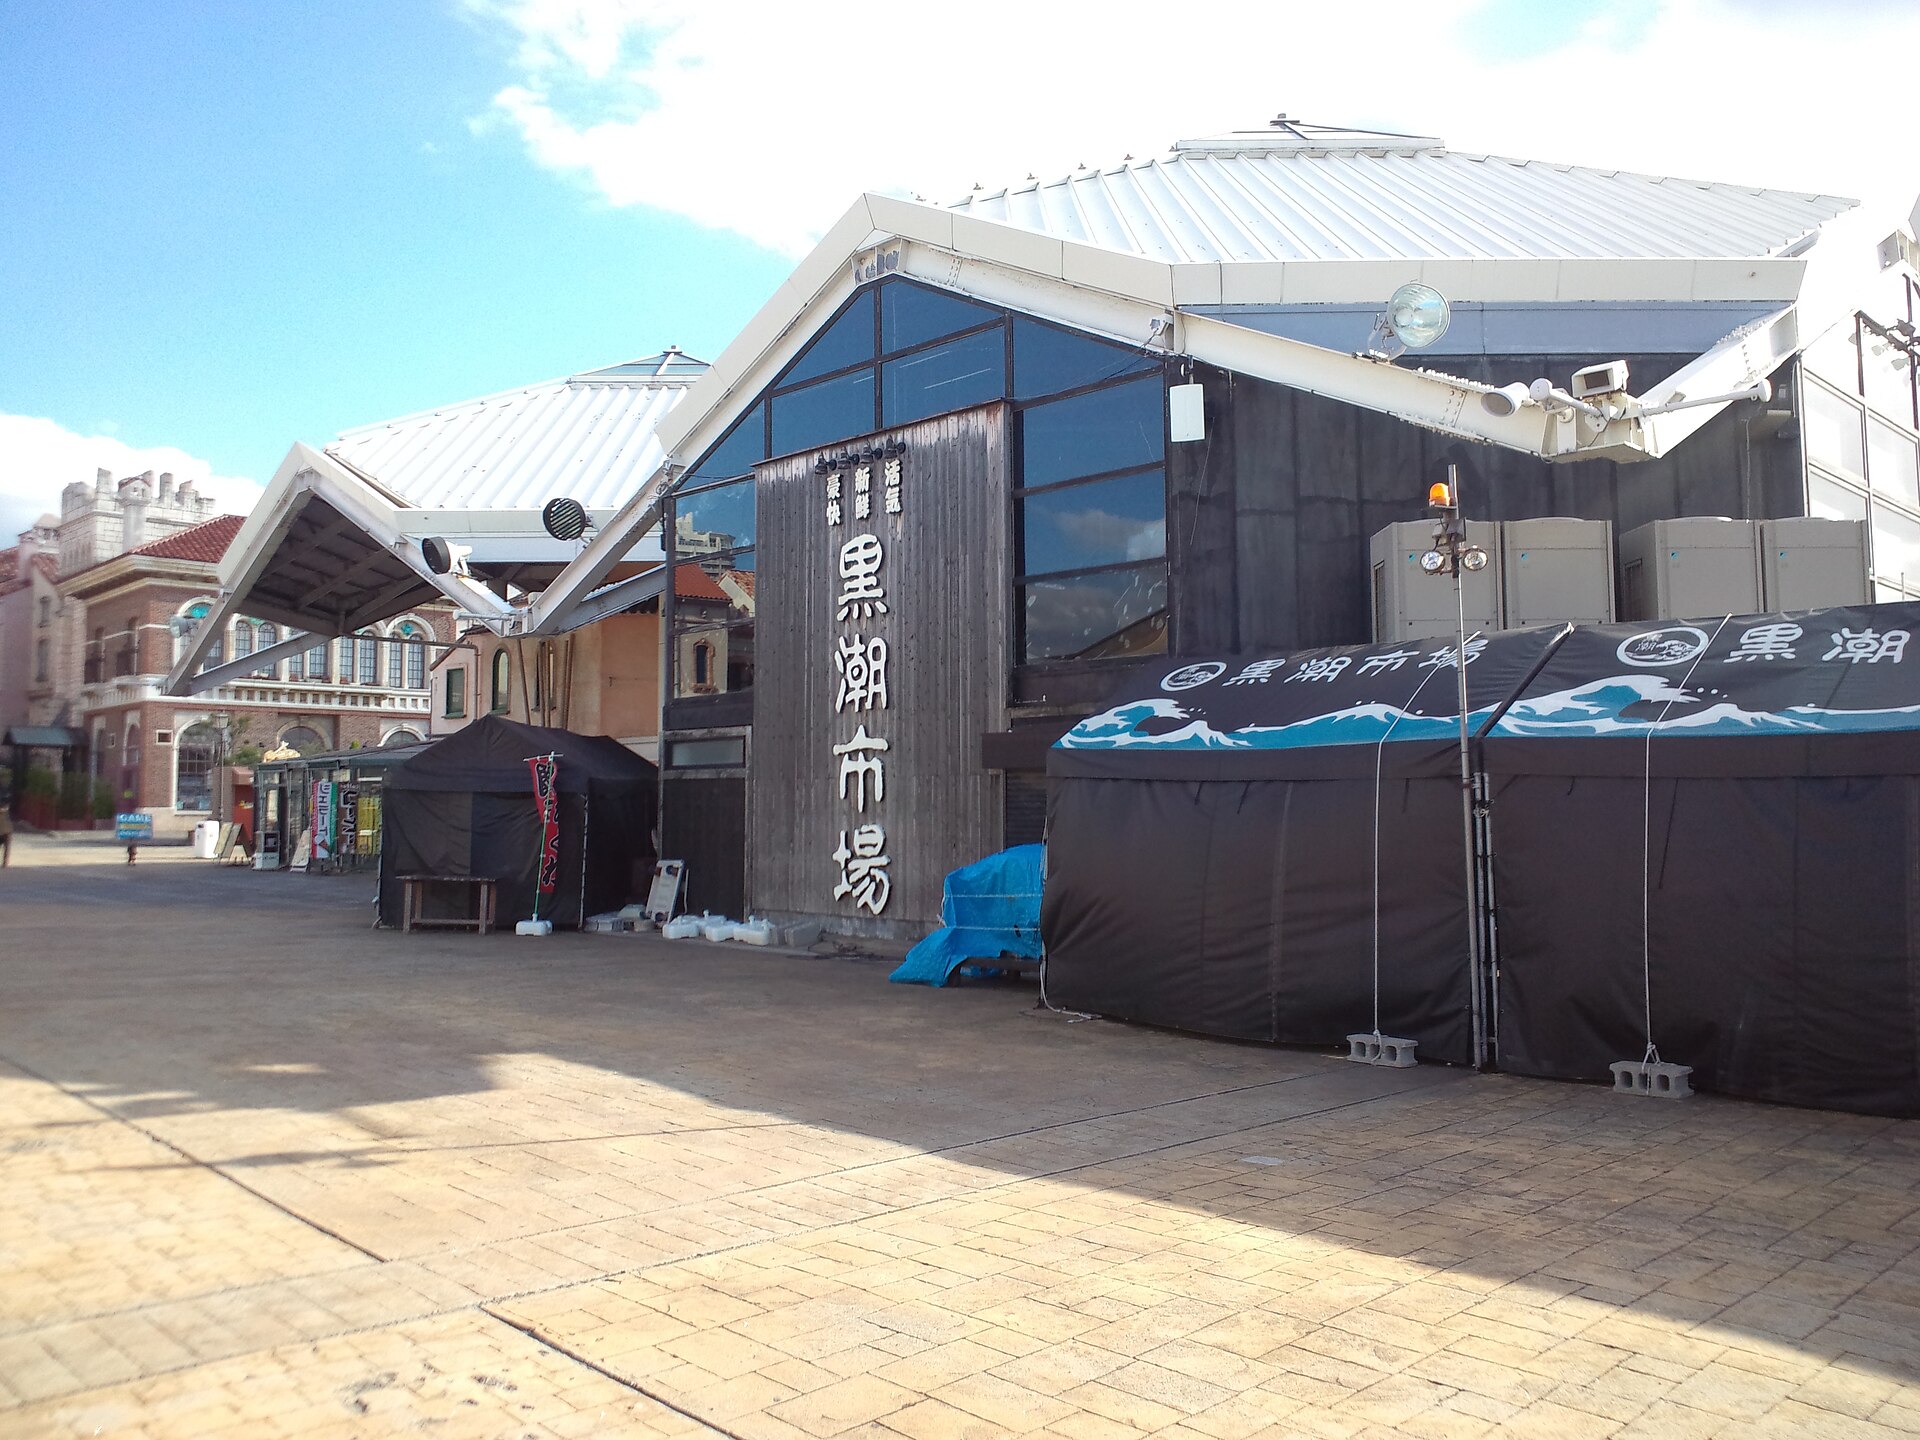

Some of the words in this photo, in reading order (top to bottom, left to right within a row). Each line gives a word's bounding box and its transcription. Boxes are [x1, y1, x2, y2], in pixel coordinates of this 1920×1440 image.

[826, 473, 841, 526] 豪快
[855, 467, 870, 519] 新鮮
[1222, 639, 1489, 687] 黒潮市場
[1723, 622, 1911, 664] 黒潮
[832, 533, 891, 915] 黒潮市場
